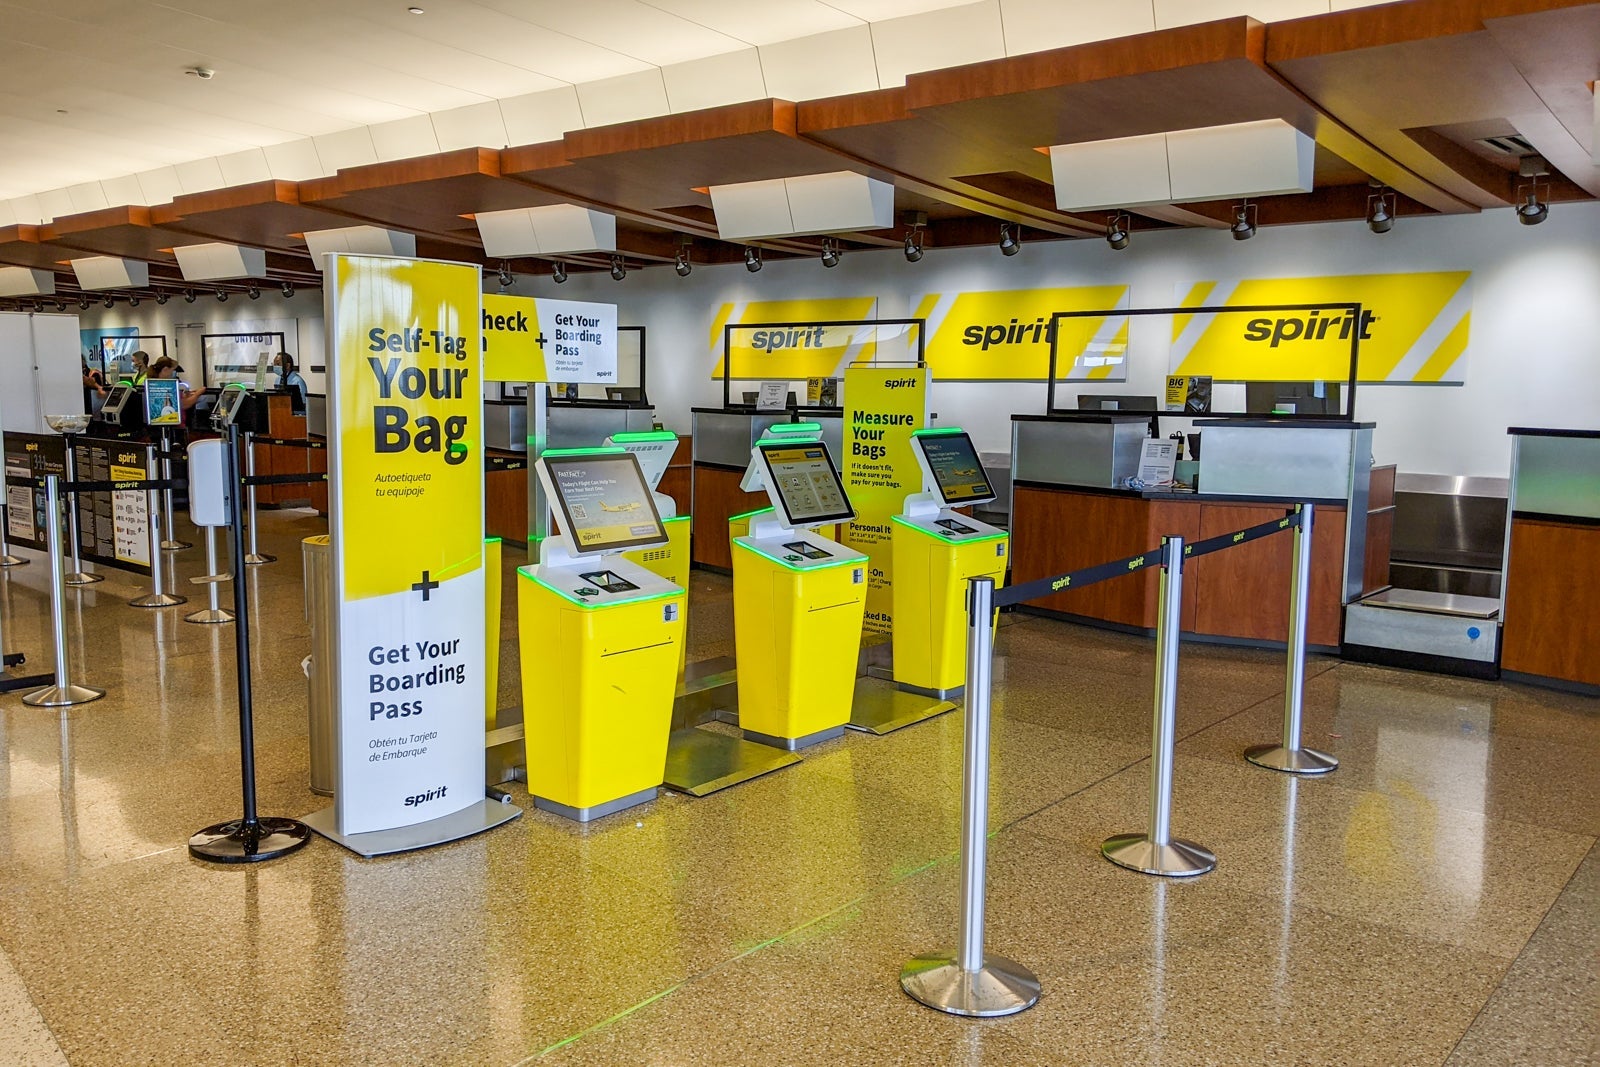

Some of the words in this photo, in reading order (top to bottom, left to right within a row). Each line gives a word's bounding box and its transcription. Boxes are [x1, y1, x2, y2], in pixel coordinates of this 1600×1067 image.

[482, 309, 528, 332] heck
[555, 314, 574, 326] Get
[576, 315, 600, 328] Your
[962, 318, 1053, 351] spirit
[1244, 310, 1376, 348] spirit
[234, 335, 264, 343] UNITED
[369, 328, 467, 361] Self-Tag
[555, 329, 602, 345] Boarding
[752, 325, 824, 353] spirit
[555, 344, 579, 356] Pass
[367, 357, 469, 400] Your
[884, 378, 917, 389] spirit
[1169, 378, 1184, 386] BIG
[853, 410, 914, 426] Measure
[374, 405, 468, 466] Bag
[852, 427, 885, 441] Your
[25, 443, 38, 451] spirit
[852, 442, 886, 460] Bags
[118, 452, 137, 465] spirit
[115, 481, 139, 489] spirit
[375, 472, 431, 483] Autoetiqueta
[886, 480, 902, 488] bags.
[375, 488, 385, 496] tu
[387, 487, 424, 498] equipaje
[850, 522, 883, 533] Personal
[583, 532, 601, 541] spirit
[1128, 556, 1144, 570] spirit
[1052, 576, 1070, 591] spirit
[369, 644, 410, 665] Get
[416, 639, 460, 660] Your
[369, 664, 465, 693] Boarding
[370, 700, 423, 721] Pass
[369, 737, 397, 749] Obtén
[398, 736, 408, 745] tu
[410, 730, 437, 744] Tarjeta
[369, 752, 381, 762] de
[382, 746, 427, 761] Embarque
[404, 785, 448, 807] spirit
